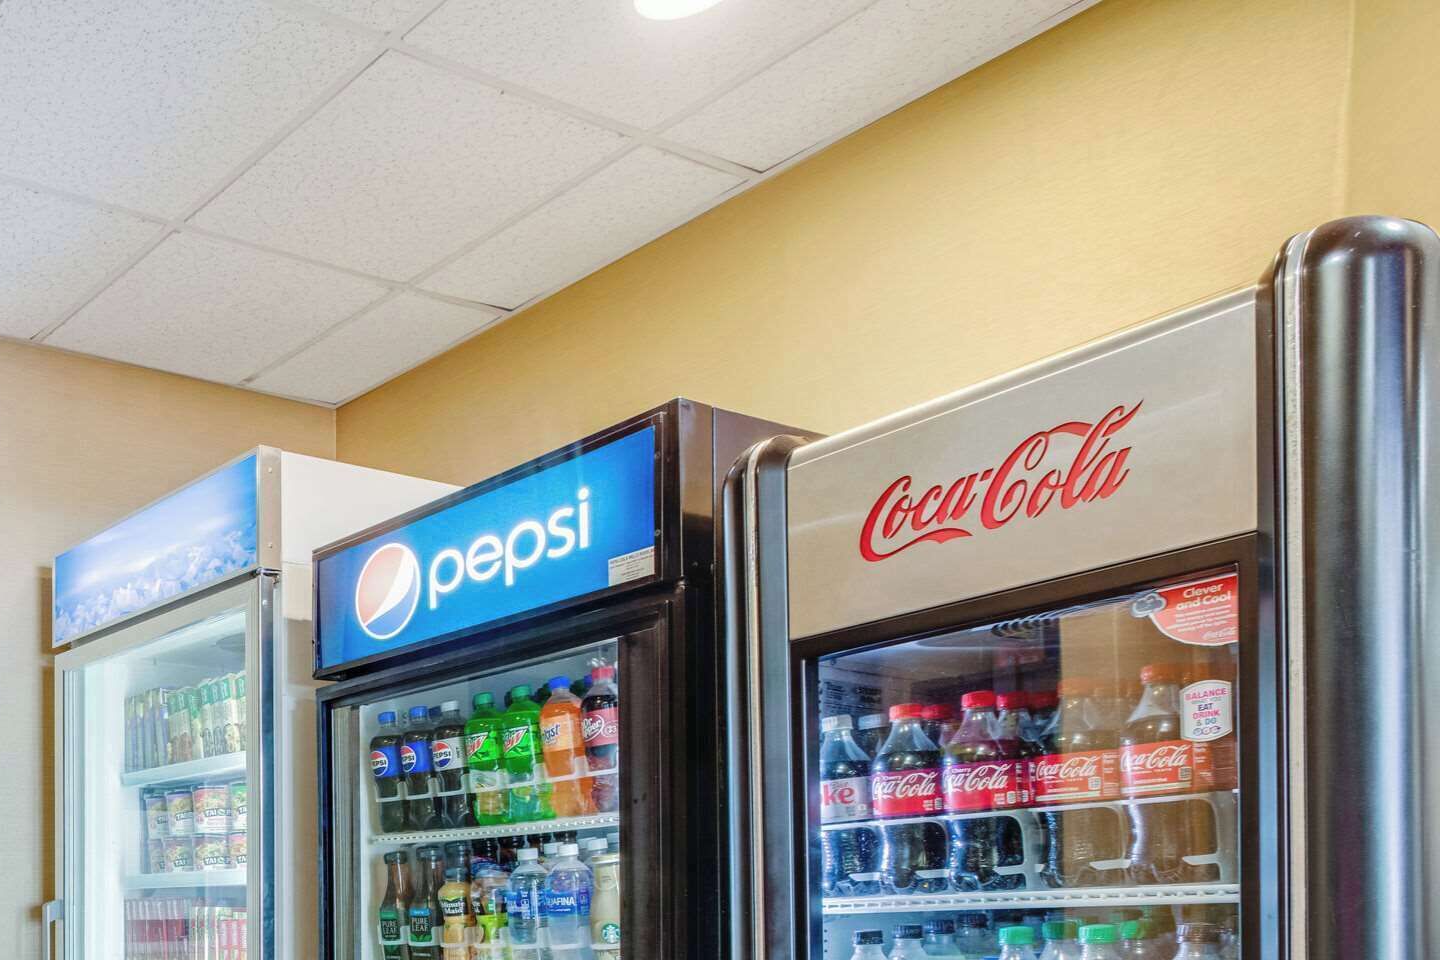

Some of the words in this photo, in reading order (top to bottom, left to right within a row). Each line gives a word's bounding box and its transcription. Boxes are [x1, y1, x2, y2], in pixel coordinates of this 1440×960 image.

[859, 399, 1144, 562] Coca-Cola
[428, 486, 591, 611] pepsi
[1183, 583, 1224, 599] Clever
[1176, 598, 1201, 611] and
[1201, 590, 1232, 606] Cool
[1184, 687, 1228, 701] BALANCE
[1197, 702, 1214, 712] EAT
[1192, 708, 1221, 721] DRINK
[823, 784, 855, 806] ke
[545, 896, 576, 906] UAFINA
[412, 917, 428, 925] PURE
[412, 924, 428, 932] LEAF
